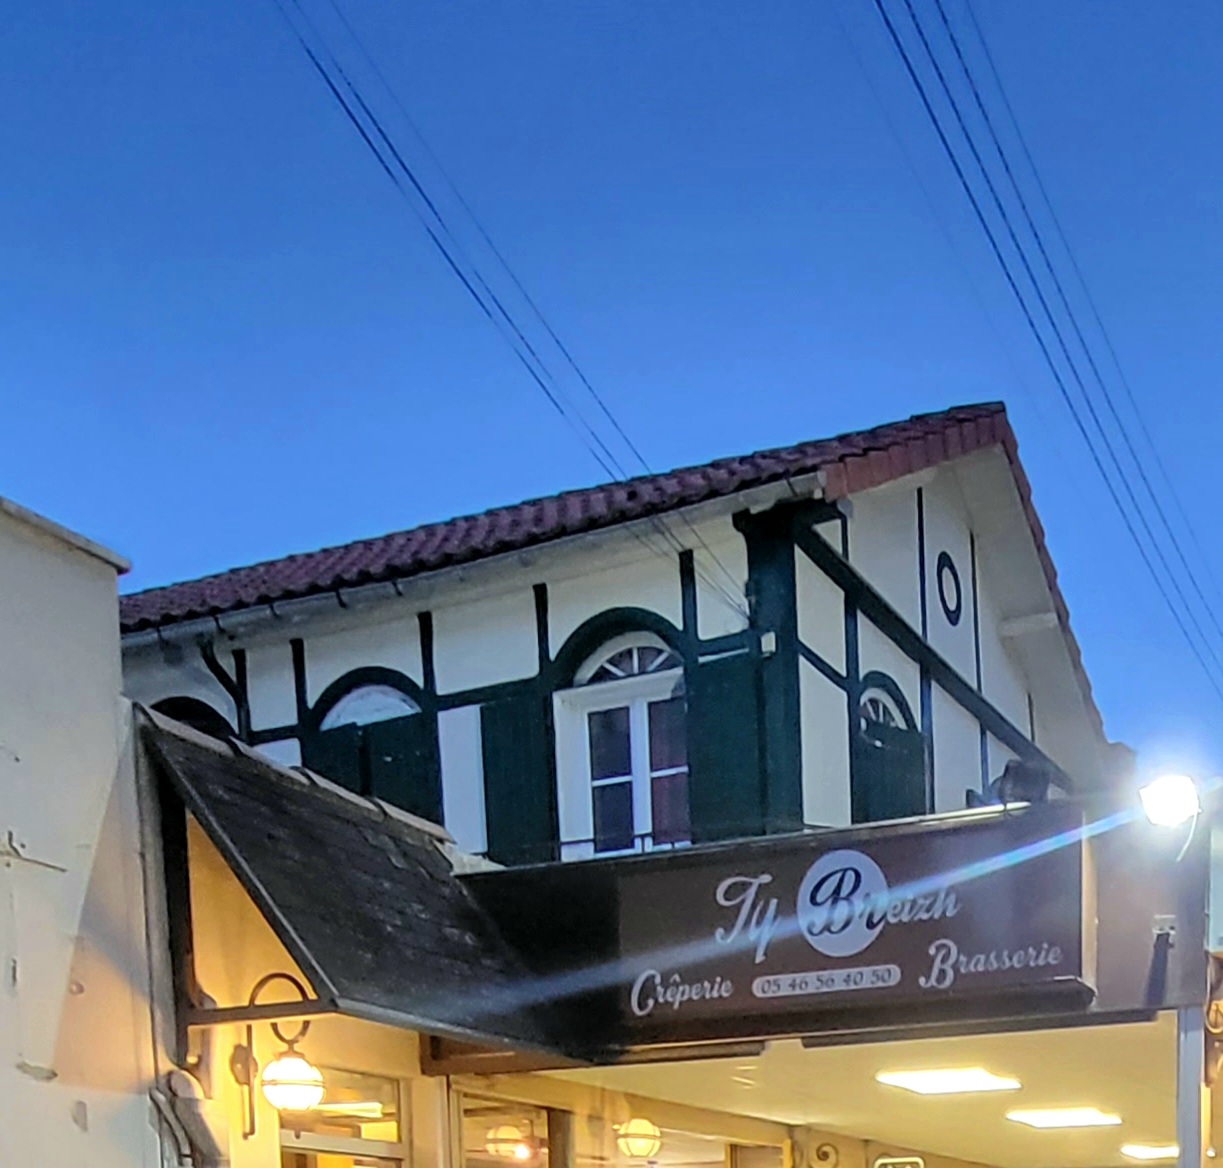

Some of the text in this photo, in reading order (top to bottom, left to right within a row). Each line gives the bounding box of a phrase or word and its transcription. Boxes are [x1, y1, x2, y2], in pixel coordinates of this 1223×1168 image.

[715, 867, 960, 964] Ty Breizh
[761, 979, 780, 995] 05
[788, 976, 808, 992] 46
[842, 971, 865, 987] 40
[869, 967, 892, 984] 50
[917, 938, 1063, 989] Brasserie
[630, 968, 734, 1017] Crêperie
